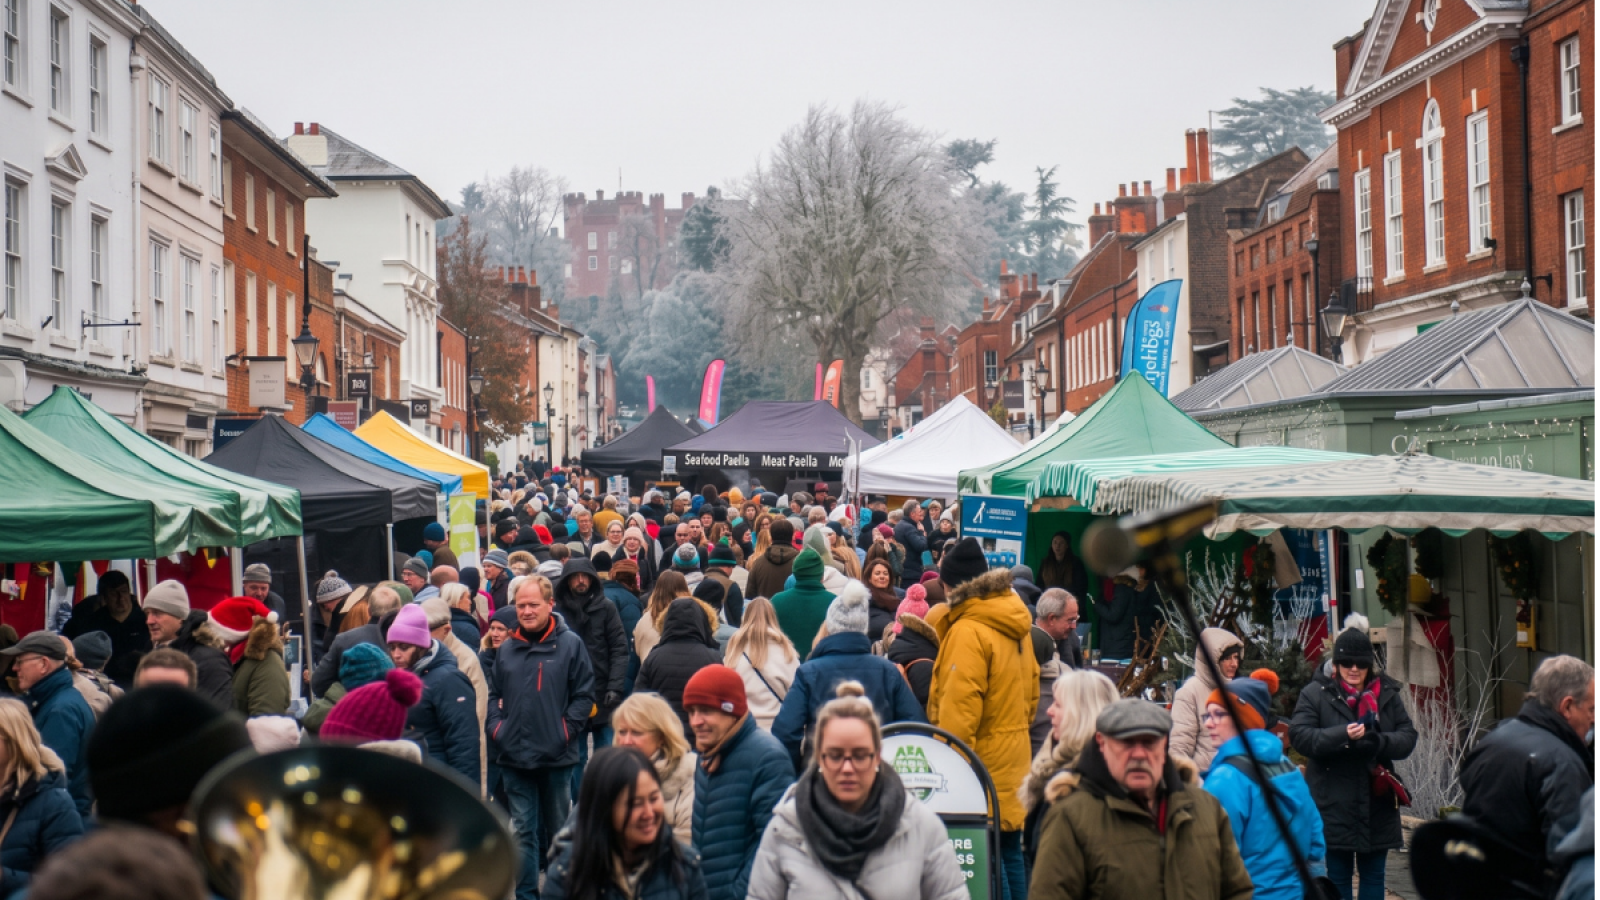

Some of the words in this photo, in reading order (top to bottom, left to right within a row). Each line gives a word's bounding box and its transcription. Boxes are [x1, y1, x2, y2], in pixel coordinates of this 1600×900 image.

[684, 452, 721, 466] Seafood
[723, 453, 750, 467] Paella
[761, 454, 786, 468] Meat
[789, 454, 818, 468] Paella
